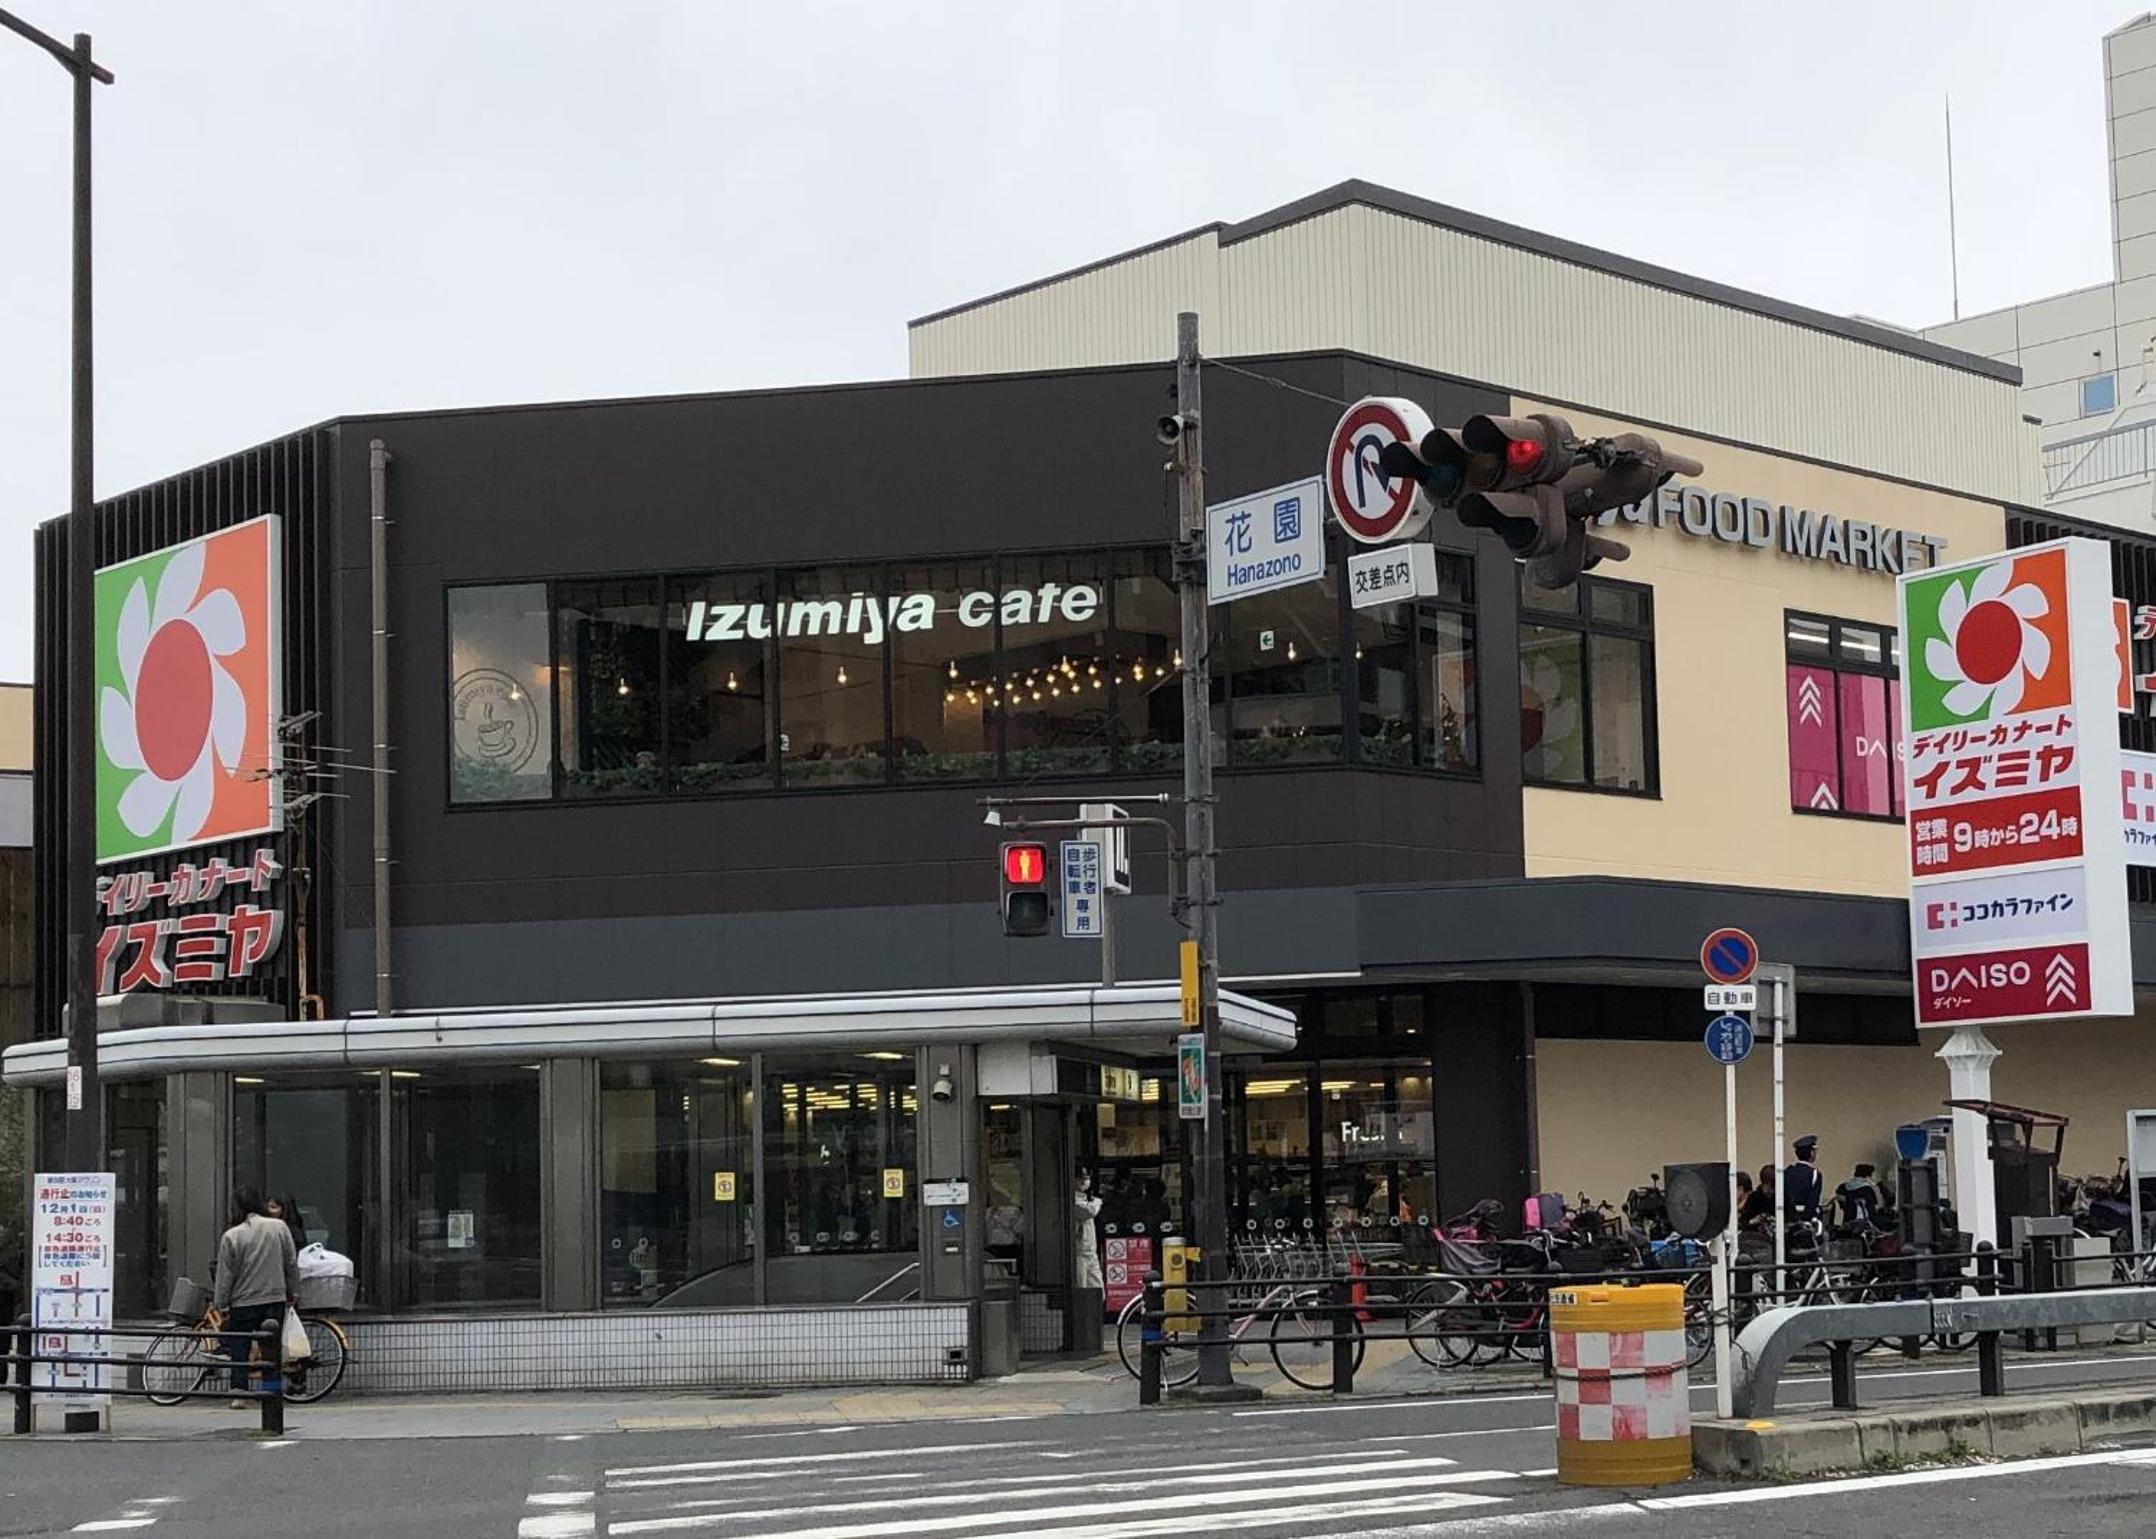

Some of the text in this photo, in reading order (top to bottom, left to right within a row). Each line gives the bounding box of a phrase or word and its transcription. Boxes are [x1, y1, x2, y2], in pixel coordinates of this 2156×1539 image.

[1224, 496, 1301, 558] 花園
[1654, 480, 1776, 549] FOOD
[1780, 505, 1949, 575] MARKET
[1226, 552, 1302, 588] Hanazono
[1355, 560, 1410, 594] 交差点内
[686, 582, 1098, 645] Izumiya cafe
[1855, 735, 1905, 762] DAIS
[1911, 713, 2073, 759] デイリーカナート
[1912, 744, 2075, 800] イズミヤ
[1915, 817, 1949, 842] 営業
[1953, 811, 2078, 853] 9時から24時
[1067, 848, 1081, 894] 自転車
[1081, 847, 1097, 895] 歩行者
[1916, 843, 1950, 866] 時間
[96, 848, 284, 916] イリーカナート
[1962, 892, 2074, 923] ココカラファイン
[1930, 960, 2032, 993] DAISO
[1707, 991, 1753, 1006] 自動車
[1932, 995, 1973, 1010] ダイソー
